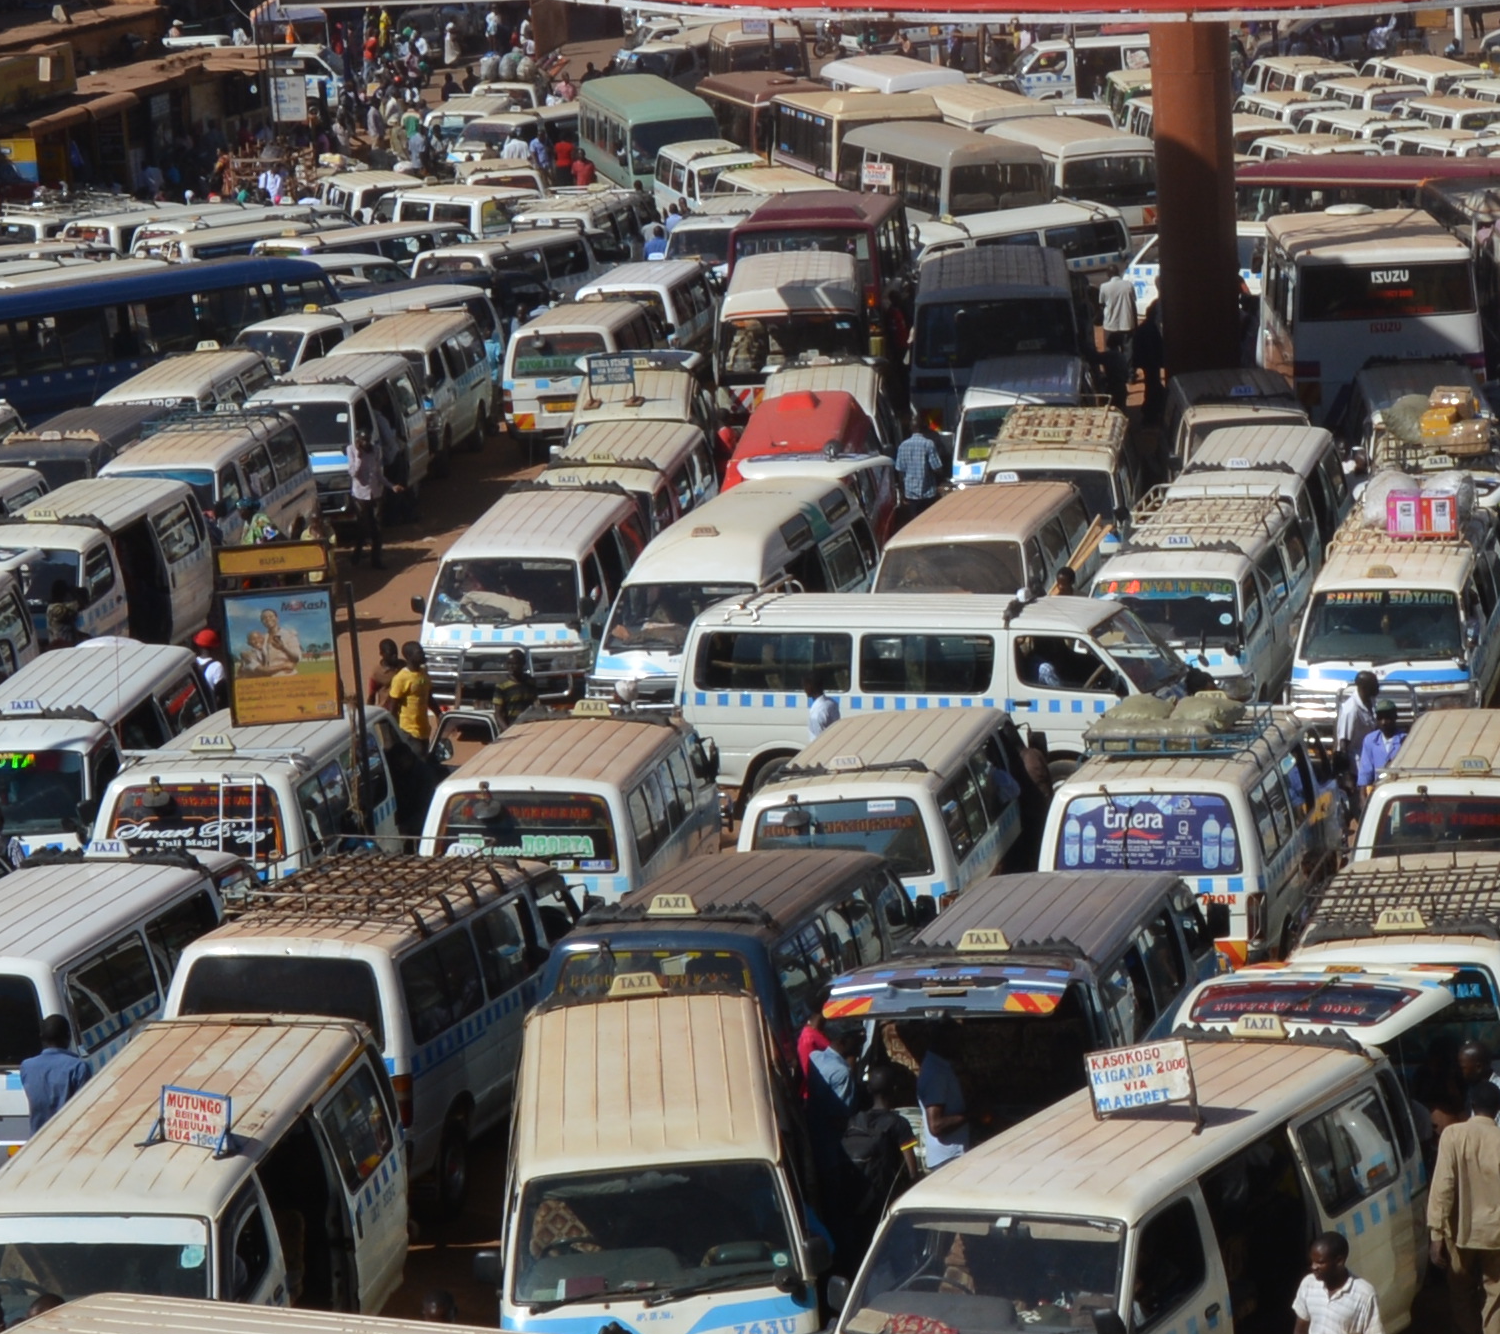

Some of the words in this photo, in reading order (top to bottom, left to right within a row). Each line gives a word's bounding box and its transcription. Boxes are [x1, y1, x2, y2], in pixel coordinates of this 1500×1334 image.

[1370, 268, 1411, 284] ISUZU
[258, 555, 287, 567] BUSIA
[1102, 805, 1164, 830] Emera
[1383, 910, 1416, 924] TAXI
[619, 975, 652, 989] TAXI
[1243, 1017, 1275, 1031] TAXI
[1090, 1046, 1162, 1070] KASOKOSO
[1124, 1078, 1148, 1093] VIA
[166, 1090, 222, 1116] MUTUNGO
